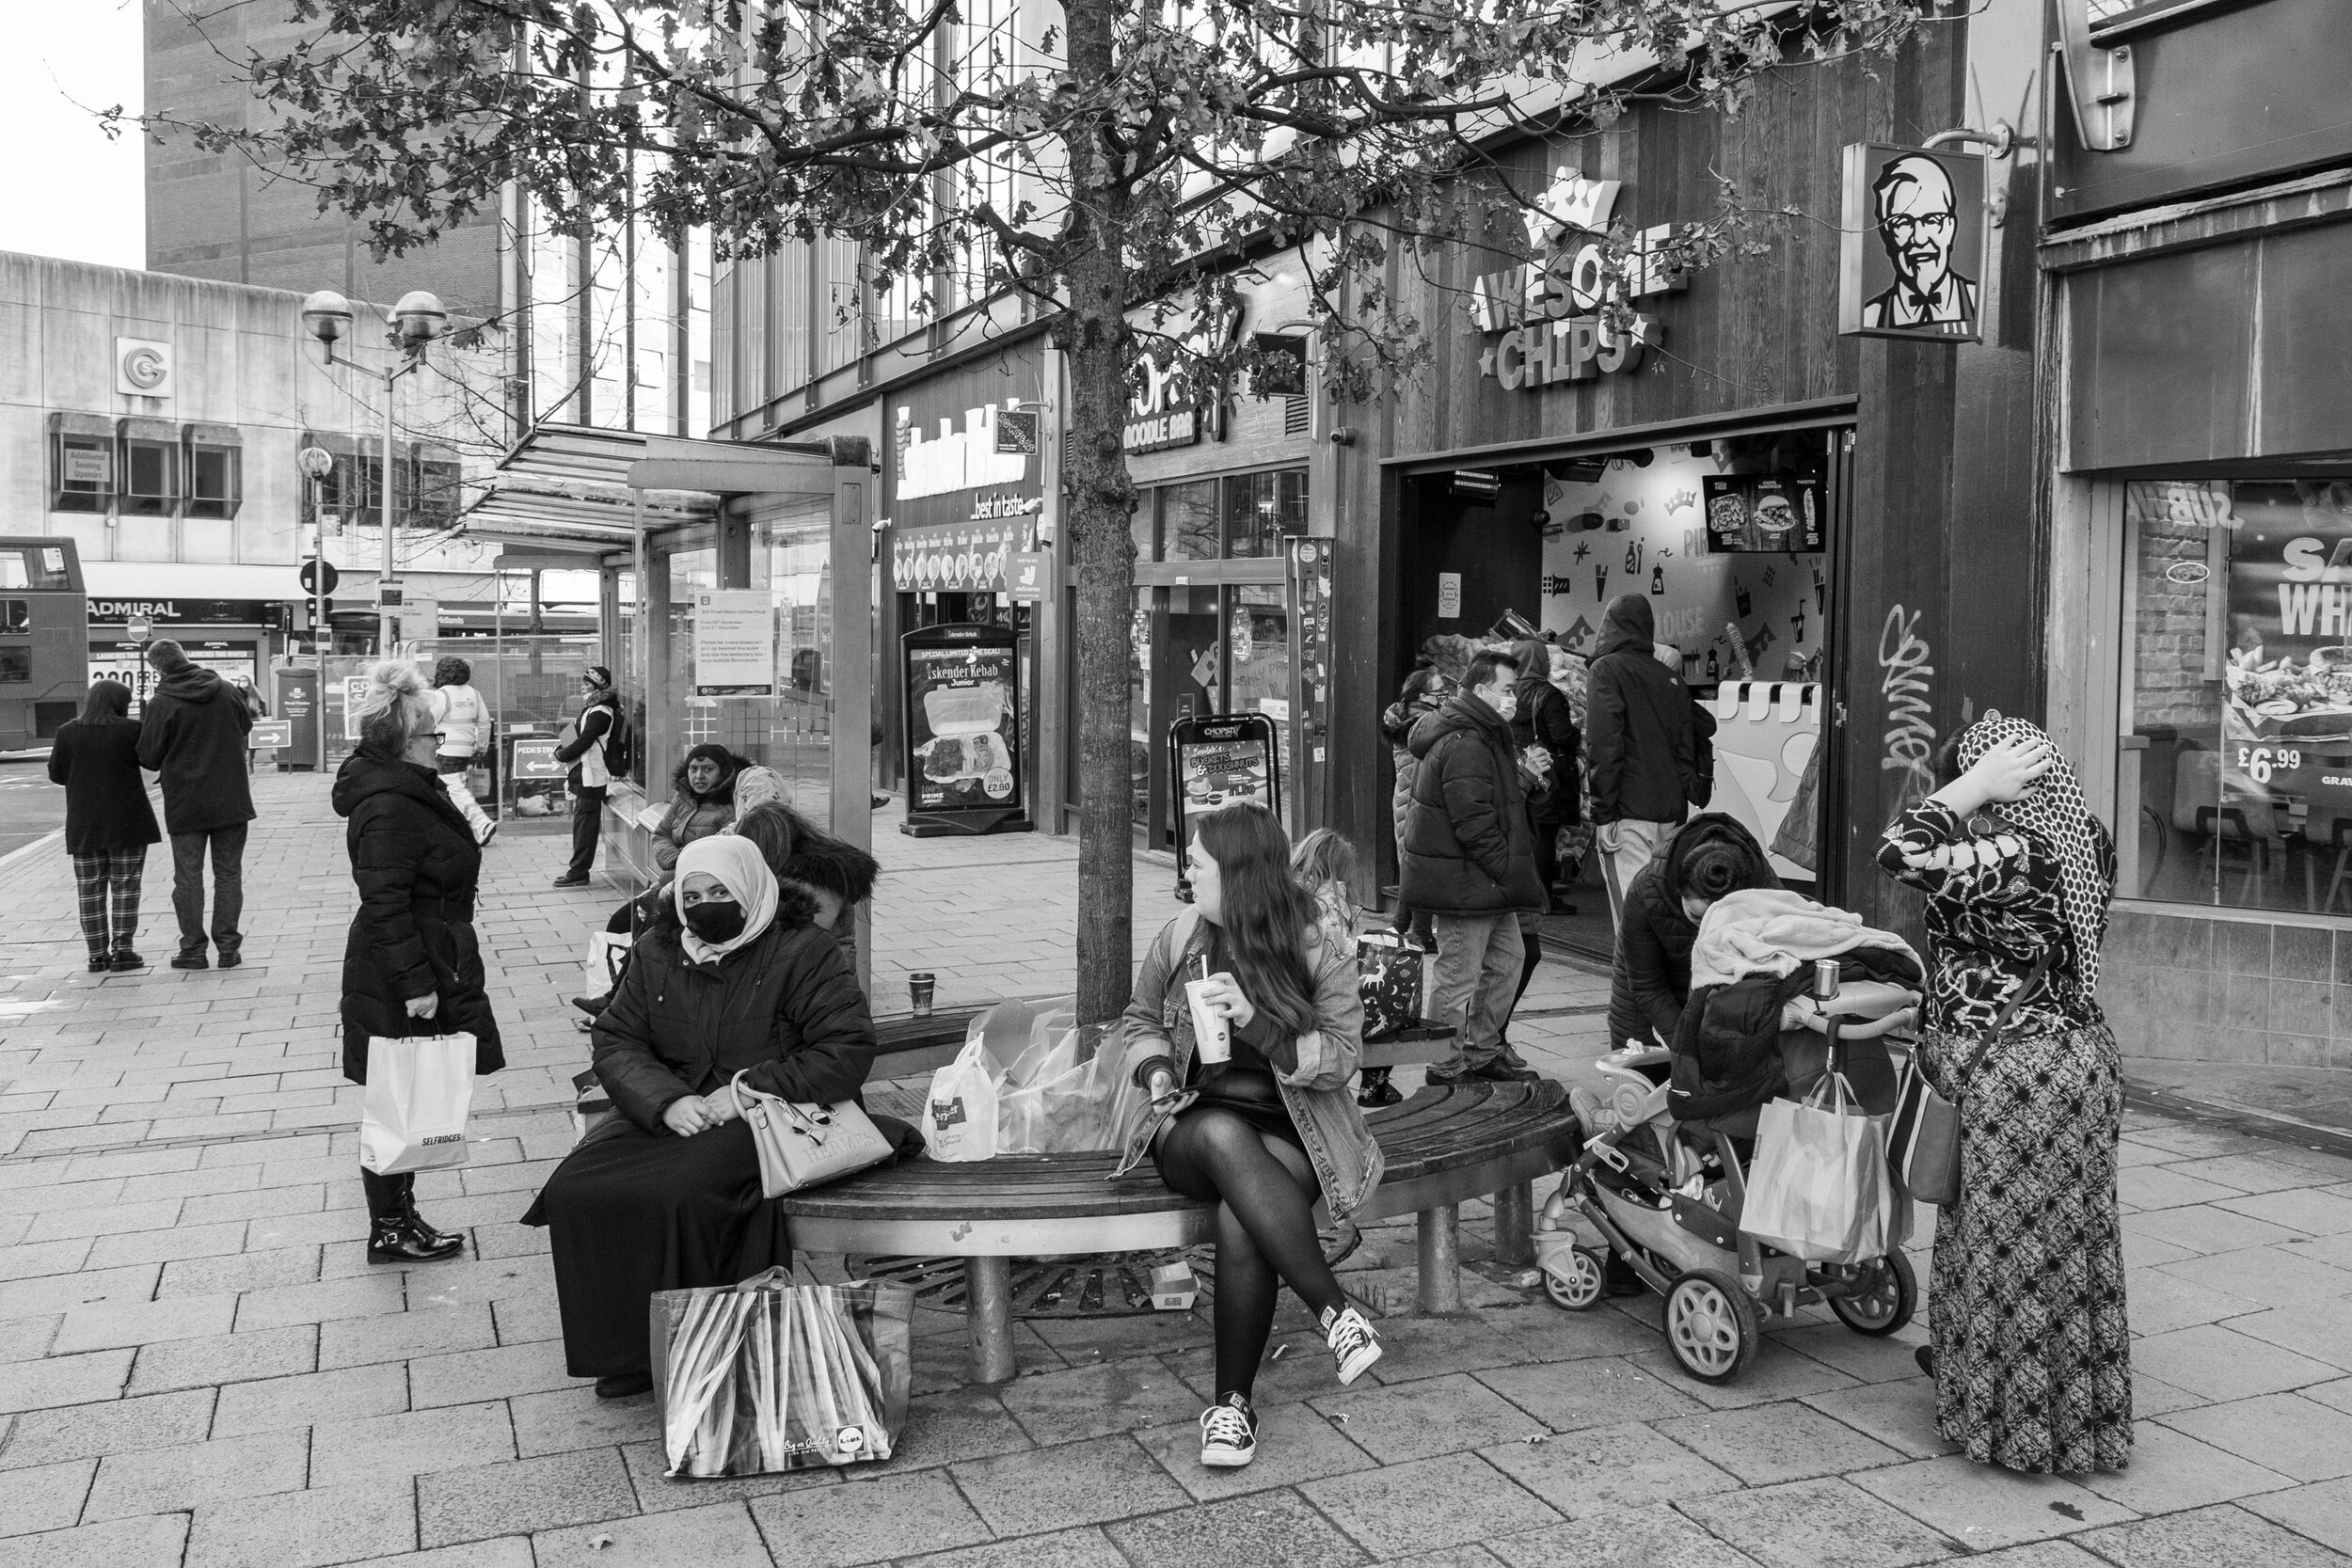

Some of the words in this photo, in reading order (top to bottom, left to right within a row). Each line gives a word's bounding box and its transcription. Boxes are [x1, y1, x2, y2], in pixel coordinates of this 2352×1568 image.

[1497, 314, 1643, 390] CHIPS
[1169, 411, 1193, 439] BAR
[70, 451, 106, 461] Additional
[75, 461, 101, 470] Seating
[74, 469, 103, 479] Upstairs
[993, 492, 1001, 517] in
[1001, 492, 1025, 516] taste
[87, 600, 182, 617] ADMIRAL
[2278, 583, 2352, 637] WH
[921, 650, 946, 658] SPECIAL
[970, 664, 998, 677] Kebab
[517, 746, 557, 754] PEDESTRI
[1191, 752, 1231, 768] BUCKETS
[1207, 756, 1259, 774] DOUGHNUTS
[2237, 747, 2301, 784] £6.99
[988, 774, 1009, 783] ONLY
[422, 1133, 461, 1147] SELFRIDGES
[784, 1439, 796, 1452] Big
[805, 1435, 831, 1449] Quality
